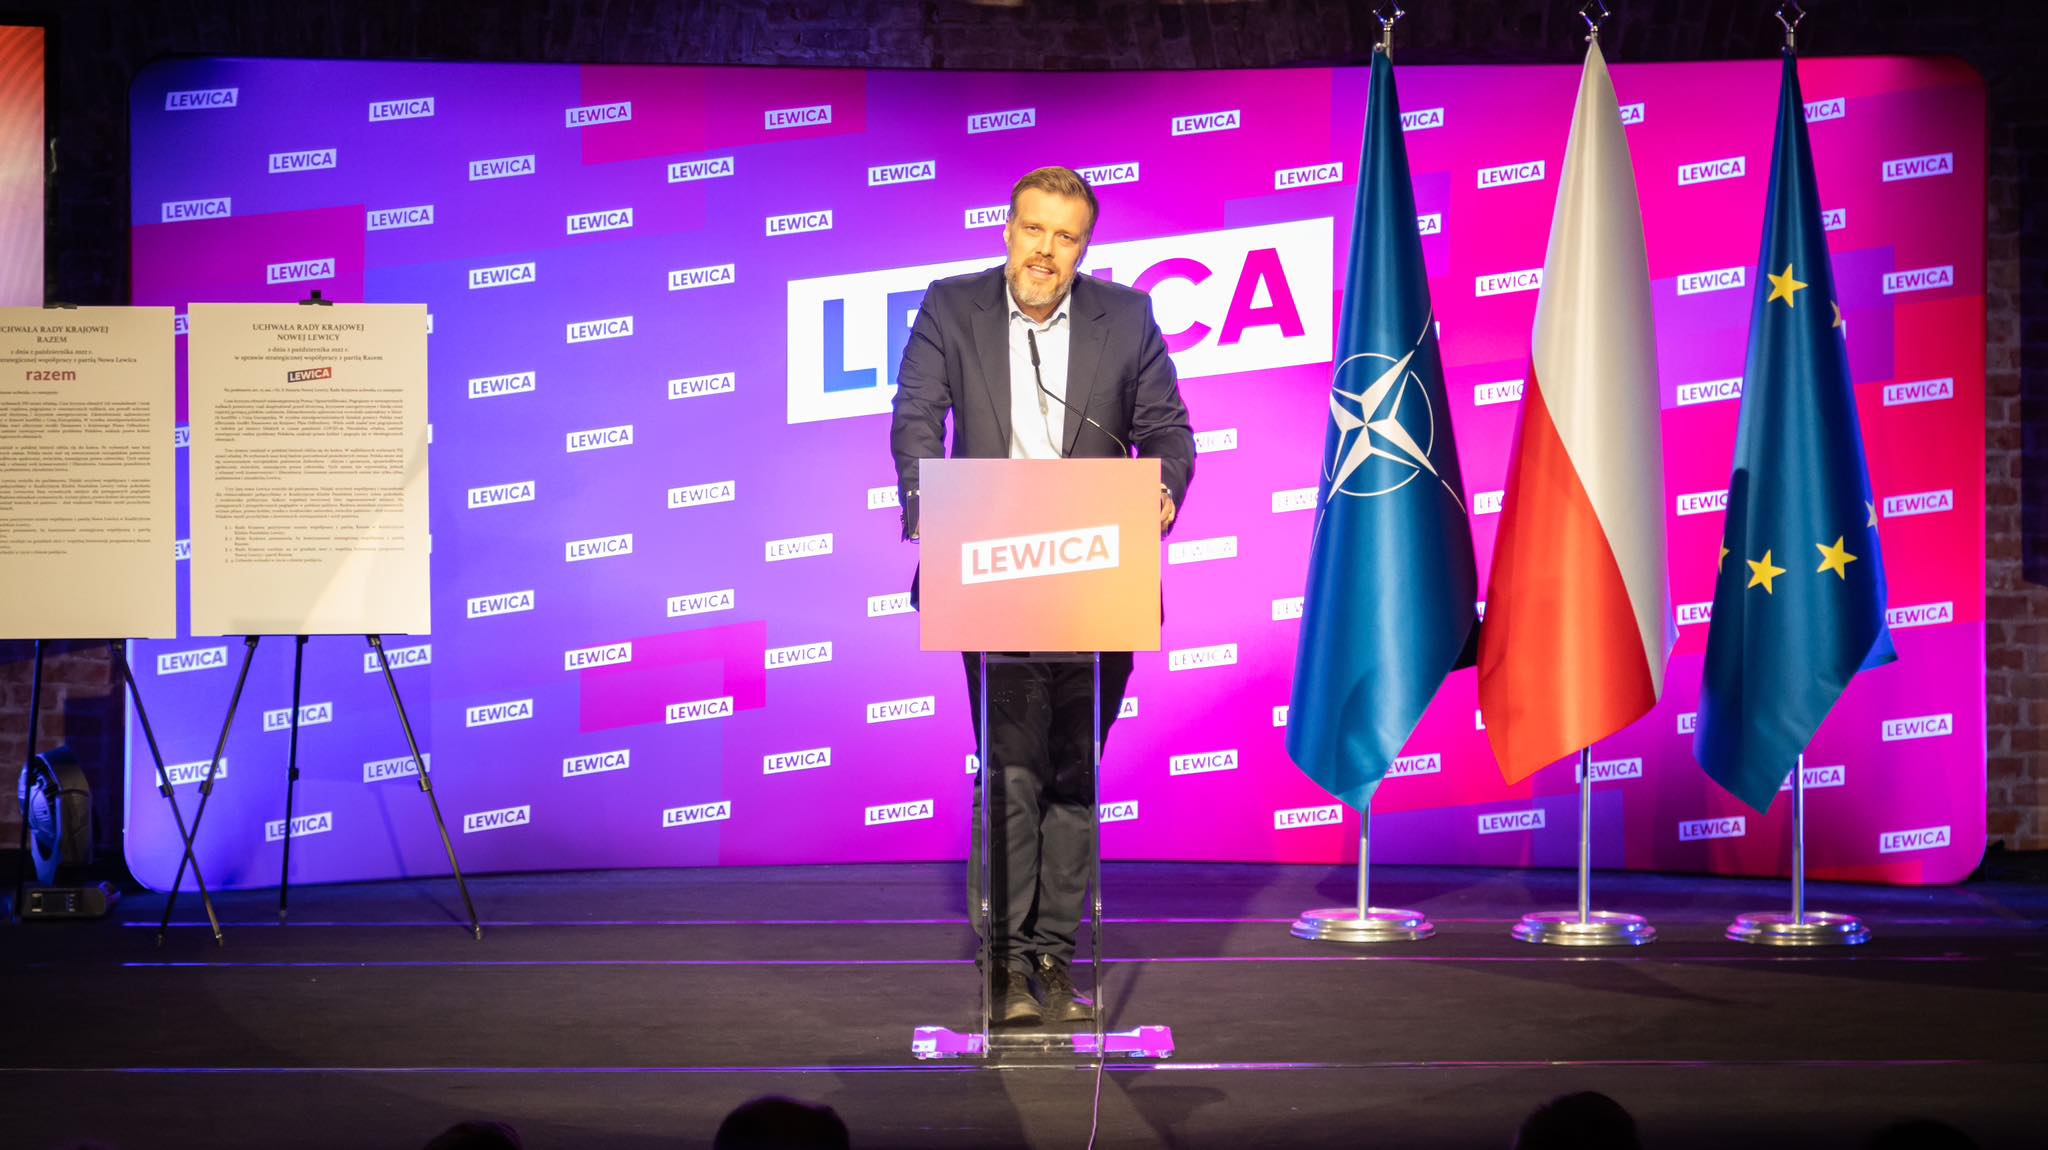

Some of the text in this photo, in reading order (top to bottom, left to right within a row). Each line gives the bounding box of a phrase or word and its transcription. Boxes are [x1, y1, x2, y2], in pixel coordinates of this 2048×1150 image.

[170, 92, 232, 108] LEWICA
[374, 101, 430, 118] LEWICA
[571, 106, 627, 123] LEWICA
[770, 109, 827, 125] LEWICA
[973, 112, 1031, 130] LEWICA
[1177, 114, 1236, 132] LEWICA
[274, 152, 332, 169] LEWICA
[474, 159, 530, 176] LEWICA
[673, 160, 730, 178] LEWICA
[1888, 157, 1949, 177] LEWICA
[873, 164, 931, 182] LEWICA
[1083, 166, 1135, 183] EWICA
[1280, 167, 1338, 185] LEWICA
[1483, 165, 1540, 184] LEWICA
[1684, 161, 1741, 180] LEWICA
[166, 202, 226, 218] LEWICA
[372, 209, 429, 226] LEWICA
[572, 212, 628, 230] LEWICA
[771, 214, 828, 232] LEWICA
[272, 263, 330, 280] LEWICA
[474, 267, 531, 285] LEWICA
[674, 268, 730, 286] LEWICA
[1888, 270, 1949, 289] LEWICA
[1481, 272, 1538, 292] LEWICA
[1683, 272, 1740, 290] LEWICA
[65, 326, 109, 334] KRAJOWEJ
[252, 323, 365, 332] UCHWAŁA RADY KRAJOWEJ
[572, 320, 629, 339] LEWICA
[26, 370, 76, 381] razem
[289, 368, 330, 382] LEWICA
[474, 376, 531, 394] LEWICA
[674, 377, 730, 395] LEWICA
[1682, 381, 1741, 401] LEWICA
[1889, 383, 1948, 401] LEWICA
[572, 430, 628, 448] LEWICA
[473, 485, 530, 504] LEWICA
[674, 486, 730, 504] LEWICA
[1682, 493, 1728, 511] LEWIC
[1888, 495, 1948, 513] LEWICA
[571, 539, 628, 557] LEWICA
[973, 535, 1109, 576] LEWICA
[472, 595, 529, 614] LEWICA
[672, 594, 729, 612] LEWICA
[1888, 607, 1948, 625] LEWICA
[162, 651, 223, 670] LEWICA
[368, 649, 427, 668] LWICA
[570, 648, 627, 666] LEWICA
[770, 647, 827, 664] LEWICA
[471, 704, 528, 723] LEWICA
[671, 701, 728, 720] LEWICA
[872, 701, 930, 718] LEWICA
[1888, 719, 1947, 736] LEWICA
[568, 754, 625, 773] LEWICA
[769, 752, 826, 770] LEWICA
[1176, 755, 1232, 770] LEWICA
[1589, 761, 1638, 779] EWICA
[468, 810, 526, 829] LEWICA
[668, 806, 726, 823] LEWICA
[871, 804, 928, 821] LEWICA
[1280, 809, 1338, 824] LEWICA
[1484, 814, 1541, 830] LEWICA
[1682, 822, 1740, 838] LEWICA
[1885, 831, 1945, 848] LEWICA
